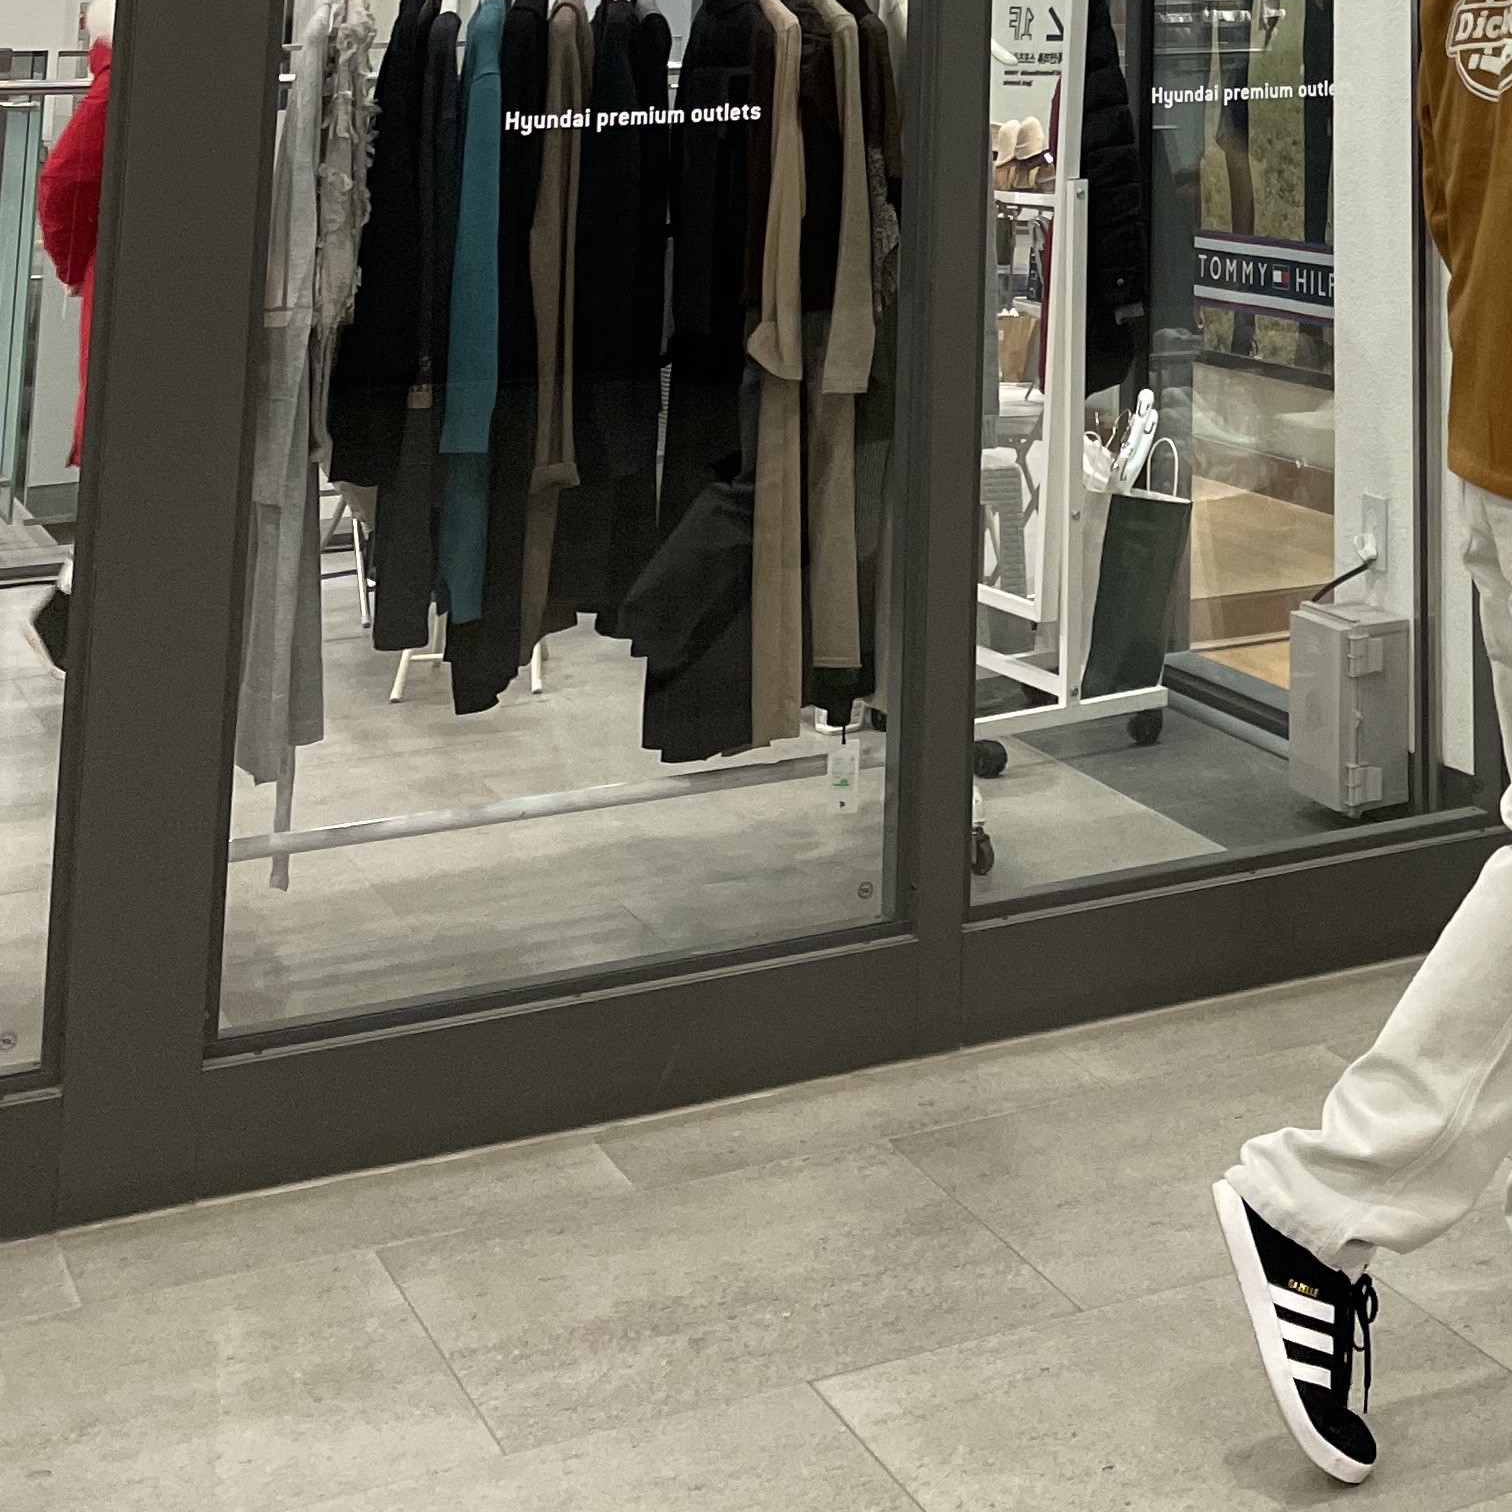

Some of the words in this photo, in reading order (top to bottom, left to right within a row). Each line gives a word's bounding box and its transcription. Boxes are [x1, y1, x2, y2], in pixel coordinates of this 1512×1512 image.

[1151, 85, 1219, 109] Hyundai
[1223, 82, 1293, 106] premium
[505, 108, 591, 136] Hyundai
[596, 105, 685, 133] premium
[690, 102, 762, 123] outlets
[1199, 254, 1268, 287] TOMMY
